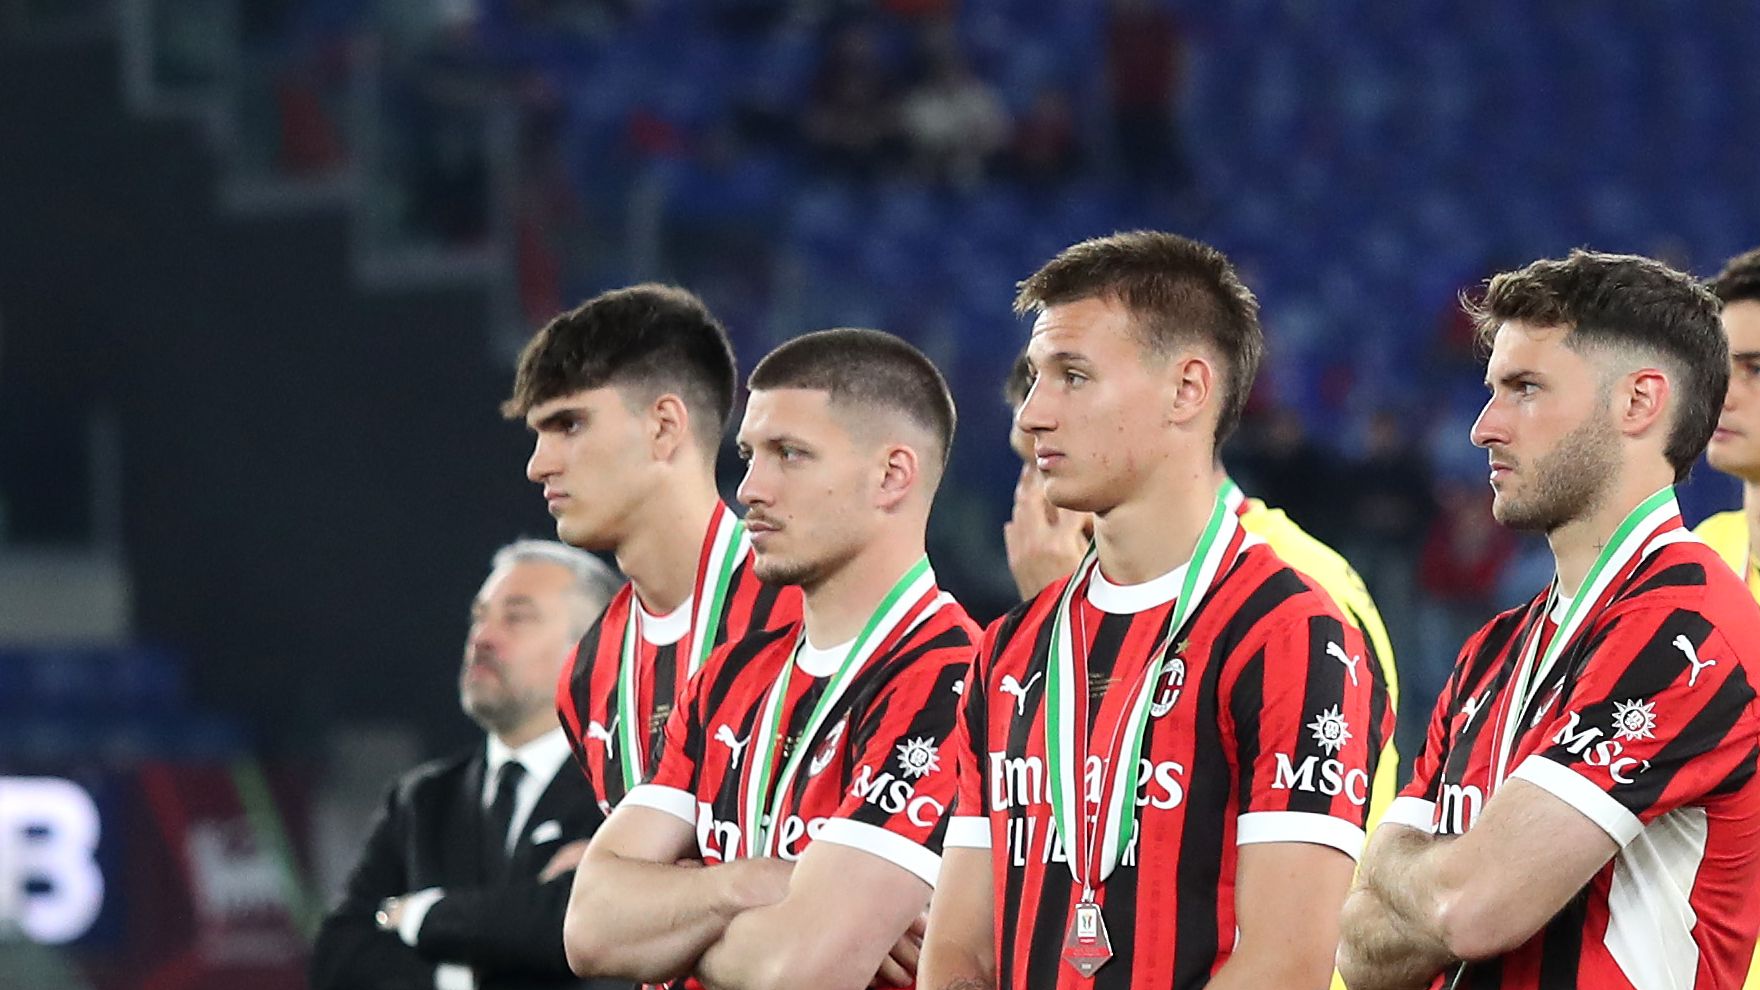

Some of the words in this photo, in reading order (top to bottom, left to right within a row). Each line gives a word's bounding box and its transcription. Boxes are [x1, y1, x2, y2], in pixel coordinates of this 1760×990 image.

[1553, 710, 1652, 784] MSC
[851, 765, 944, 827] MSC
[1271, 752, 1368, 806] MSC
